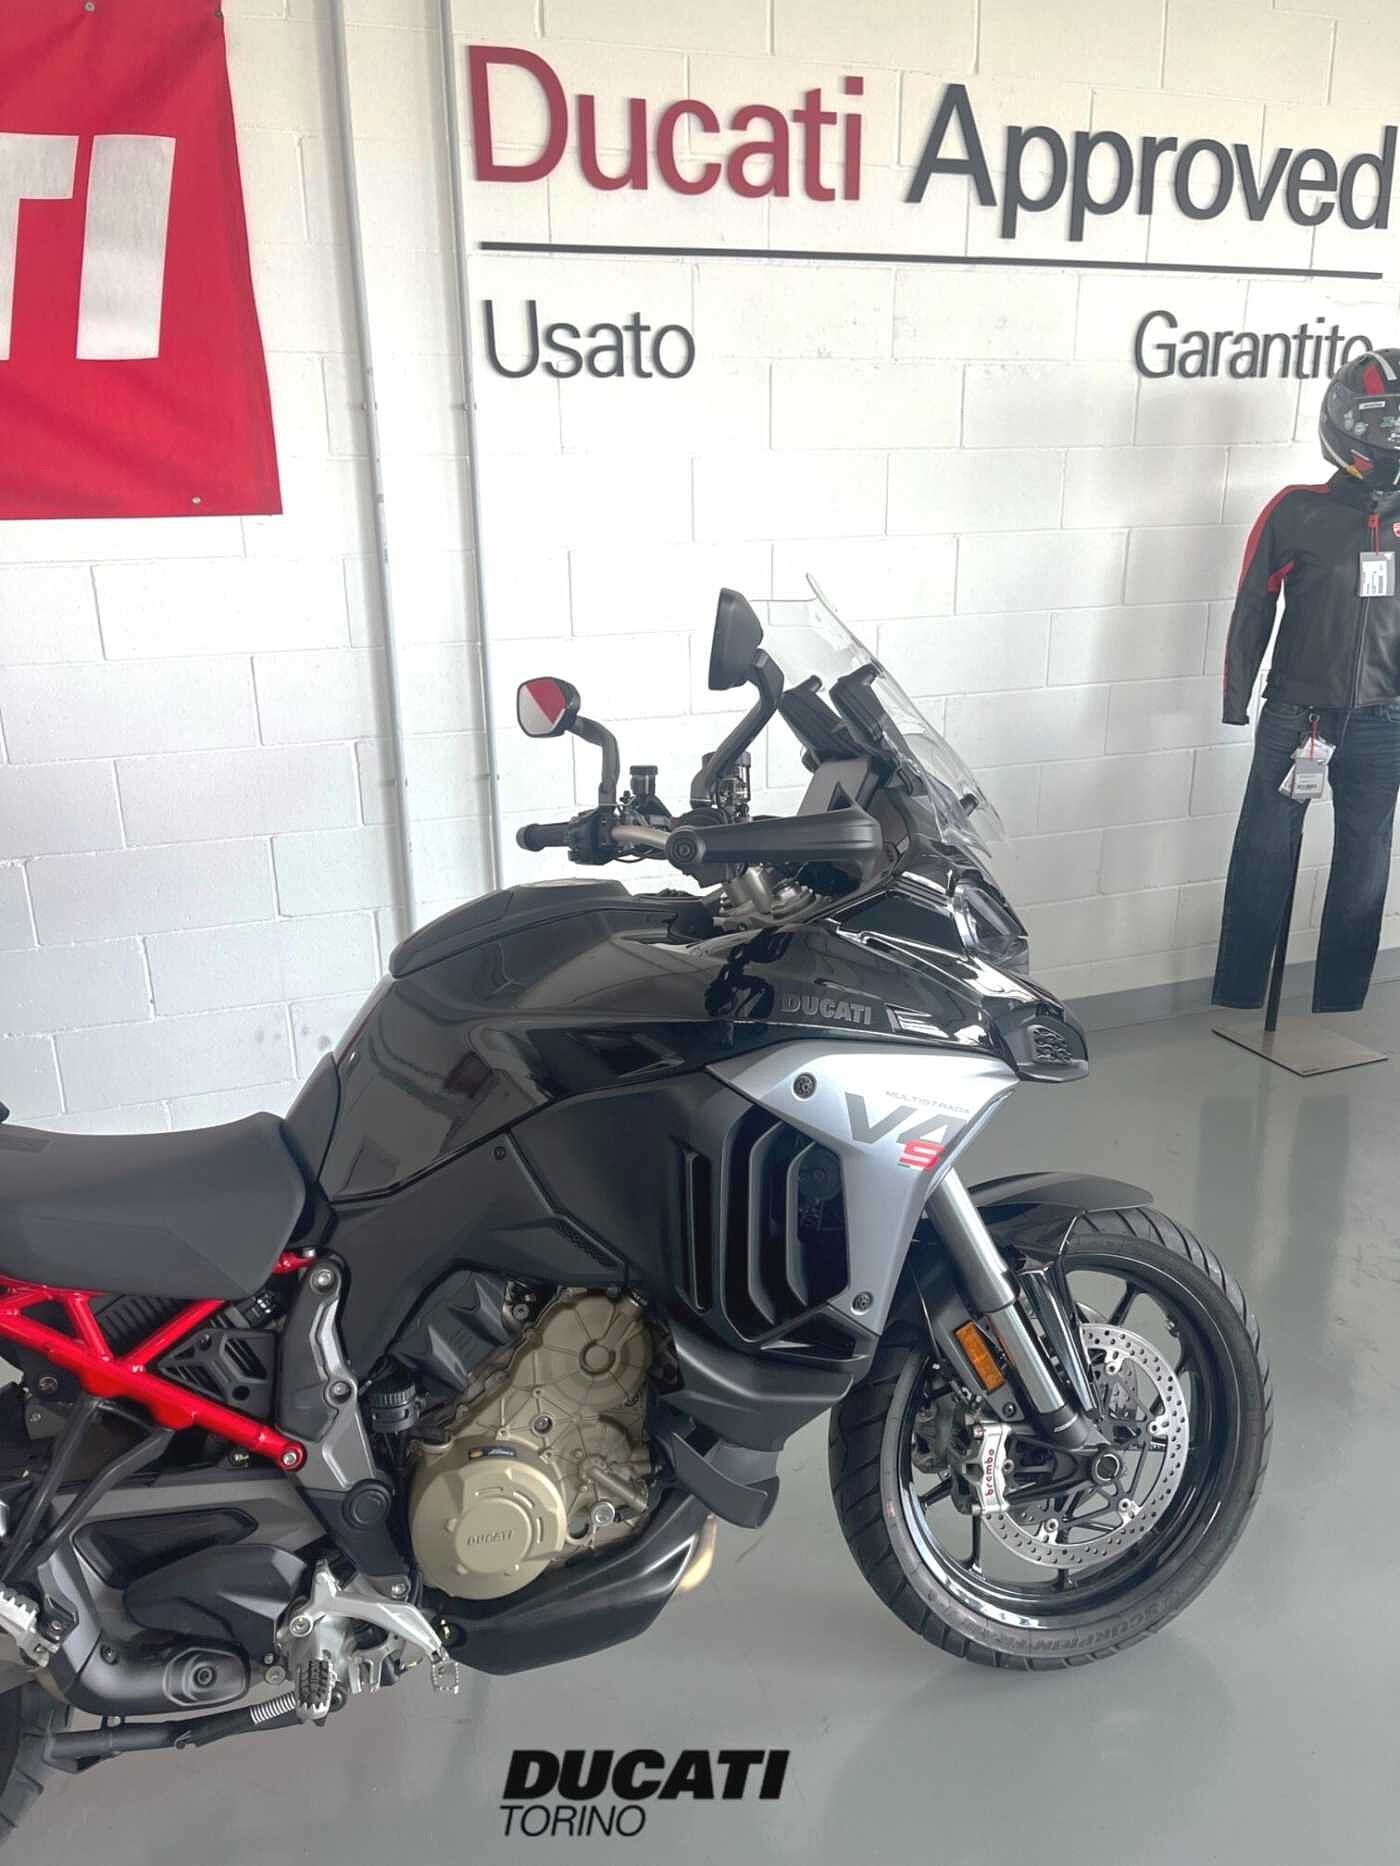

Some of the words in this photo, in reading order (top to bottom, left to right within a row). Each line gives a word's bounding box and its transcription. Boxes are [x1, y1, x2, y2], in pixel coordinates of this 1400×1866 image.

[466, 45, 864, 202] Ducati
[905, 83, 1398, 241] Approved
[483, 300, 695, 378] Usato
[780, 993, 871, 1026] DUCATI
[844, 1091, 967, 1144] V4
[885, 1090, 970, 1114] MULTISTRADA
[896, 1139, 945, 1171] S
[983, 1448, 995, 1497] brembo
